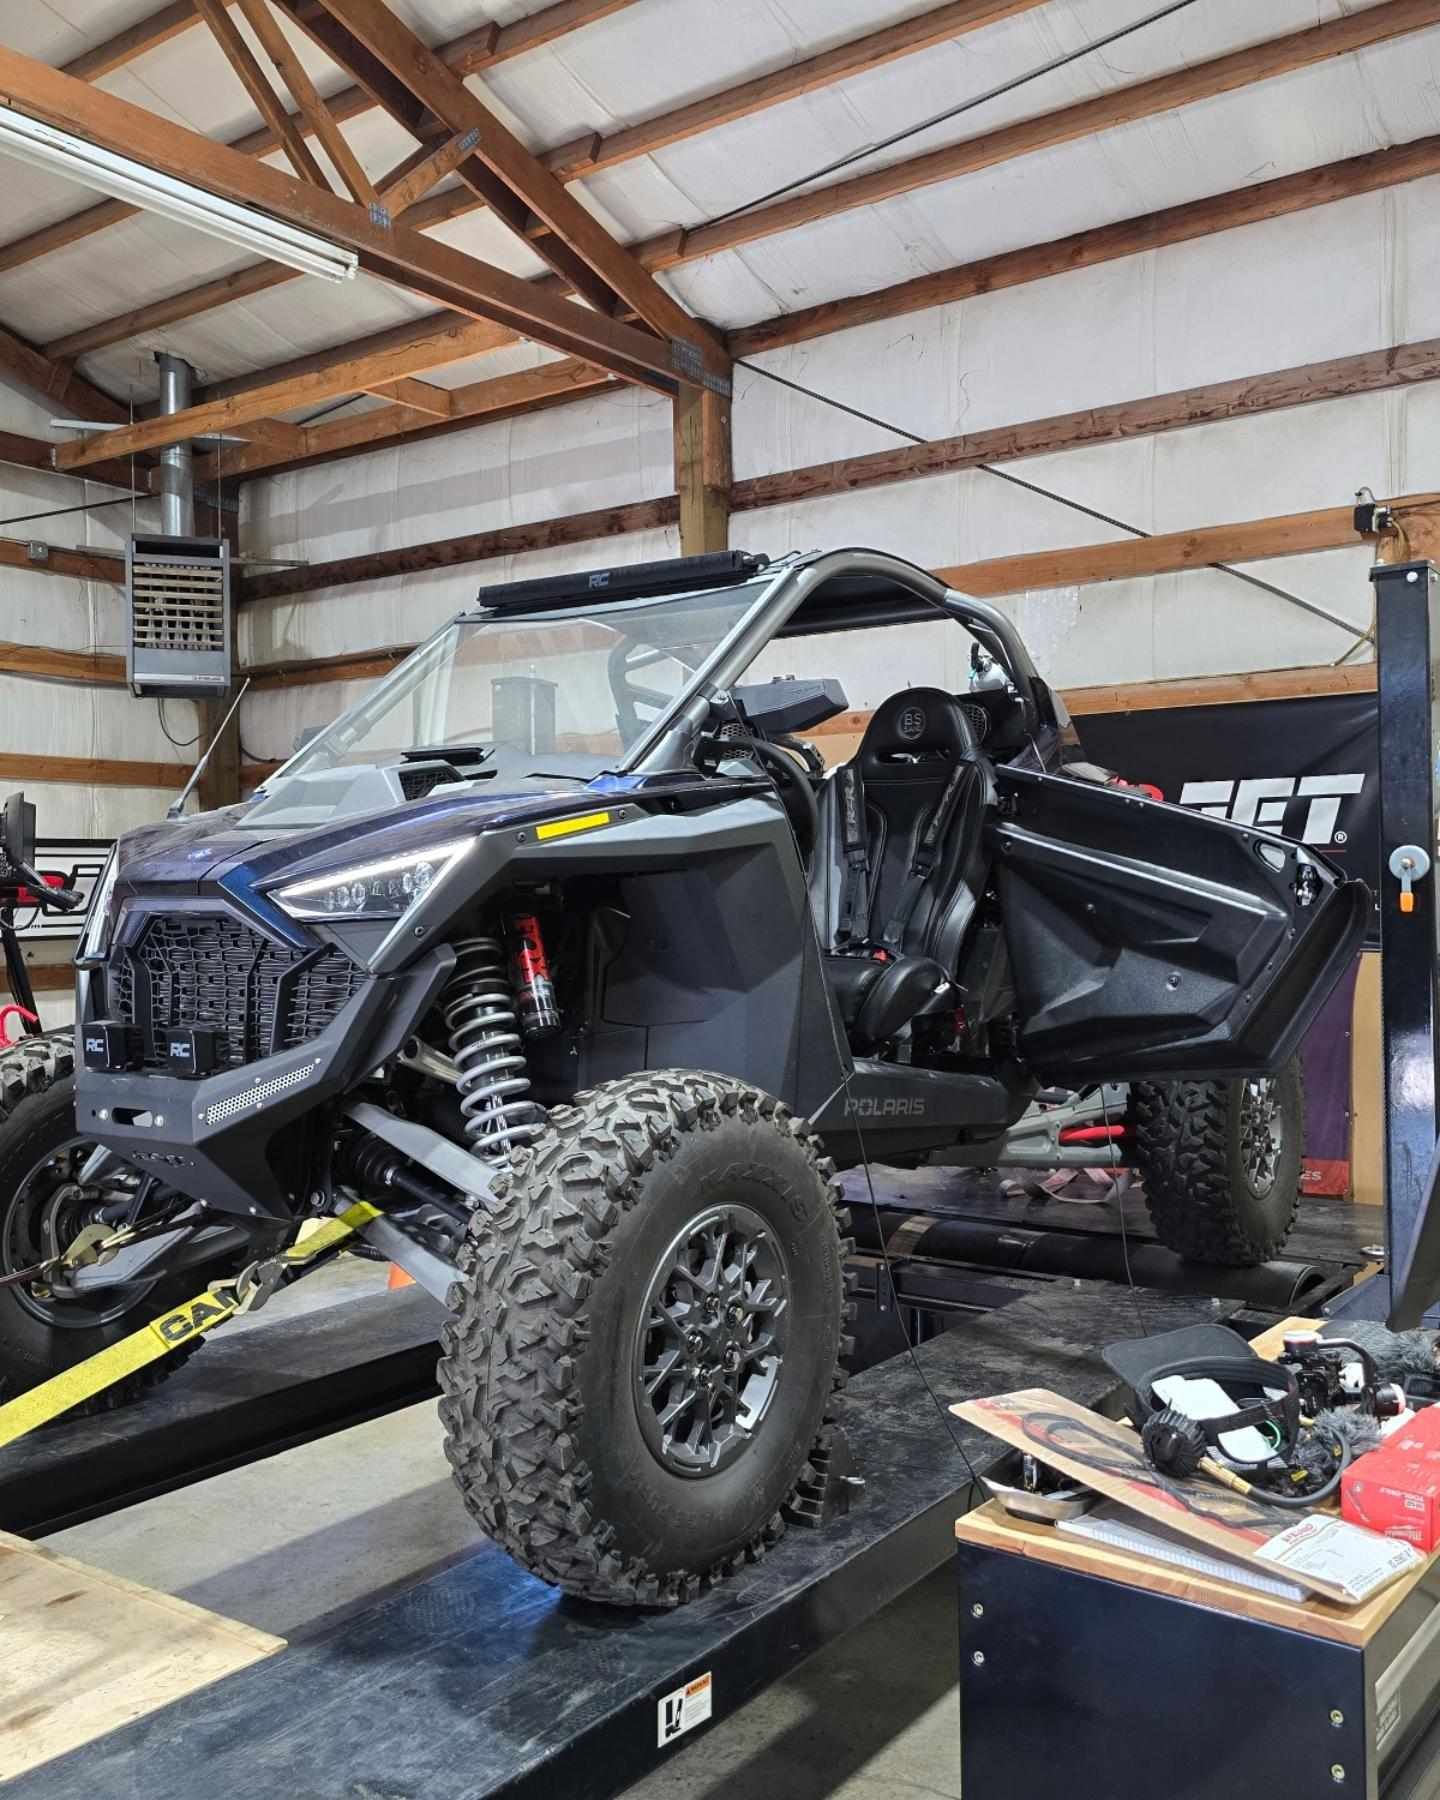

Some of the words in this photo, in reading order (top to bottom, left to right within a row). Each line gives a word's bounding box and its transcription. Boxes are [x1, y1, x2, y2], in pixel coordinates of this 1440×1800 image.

[588, 572, 609, 589] RC
[86, 1038, 104, 1052] RC
[170, 1042, 190, 1057] RC
[844, 1097, 926, 1117] POLARIS
